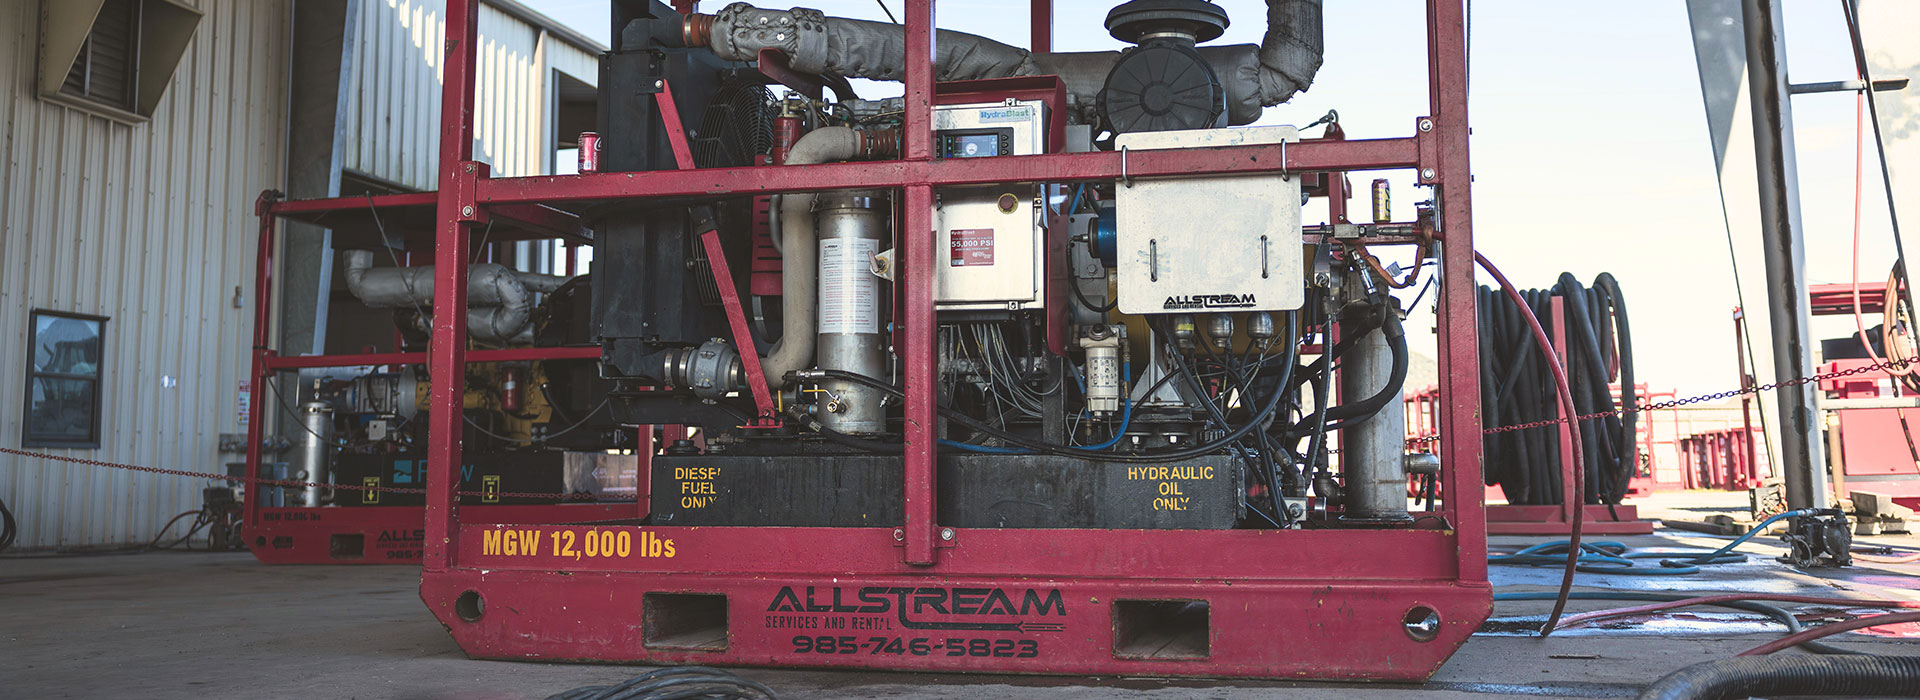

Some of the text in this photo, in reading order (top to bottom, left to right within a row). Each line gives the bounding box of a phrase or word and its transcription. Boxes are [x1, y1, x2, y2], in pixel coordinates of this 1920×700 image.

[980, 109, 1029, 119] HydraBlast
[951, 240, 978, 248] 55,000
[1163, 293, 1256, 306] ALLSTREAM
[1128, 466, 1214, 480] HYDRAULIC
[681, 481, 717, 494] FUEL
[1158, 481, 1183, 495] OIL
[1153, 497, 1190, 511] ONLY
[483, 530, 676, 561] MGW 12,000 lbs
[766, 586, 1067, 620] ALLSTREAM
[765, 615, 818, 629] SERVICES
[824, 616, 845, 629] AND
[792, 635, 1039, 658] 985-746-5823
